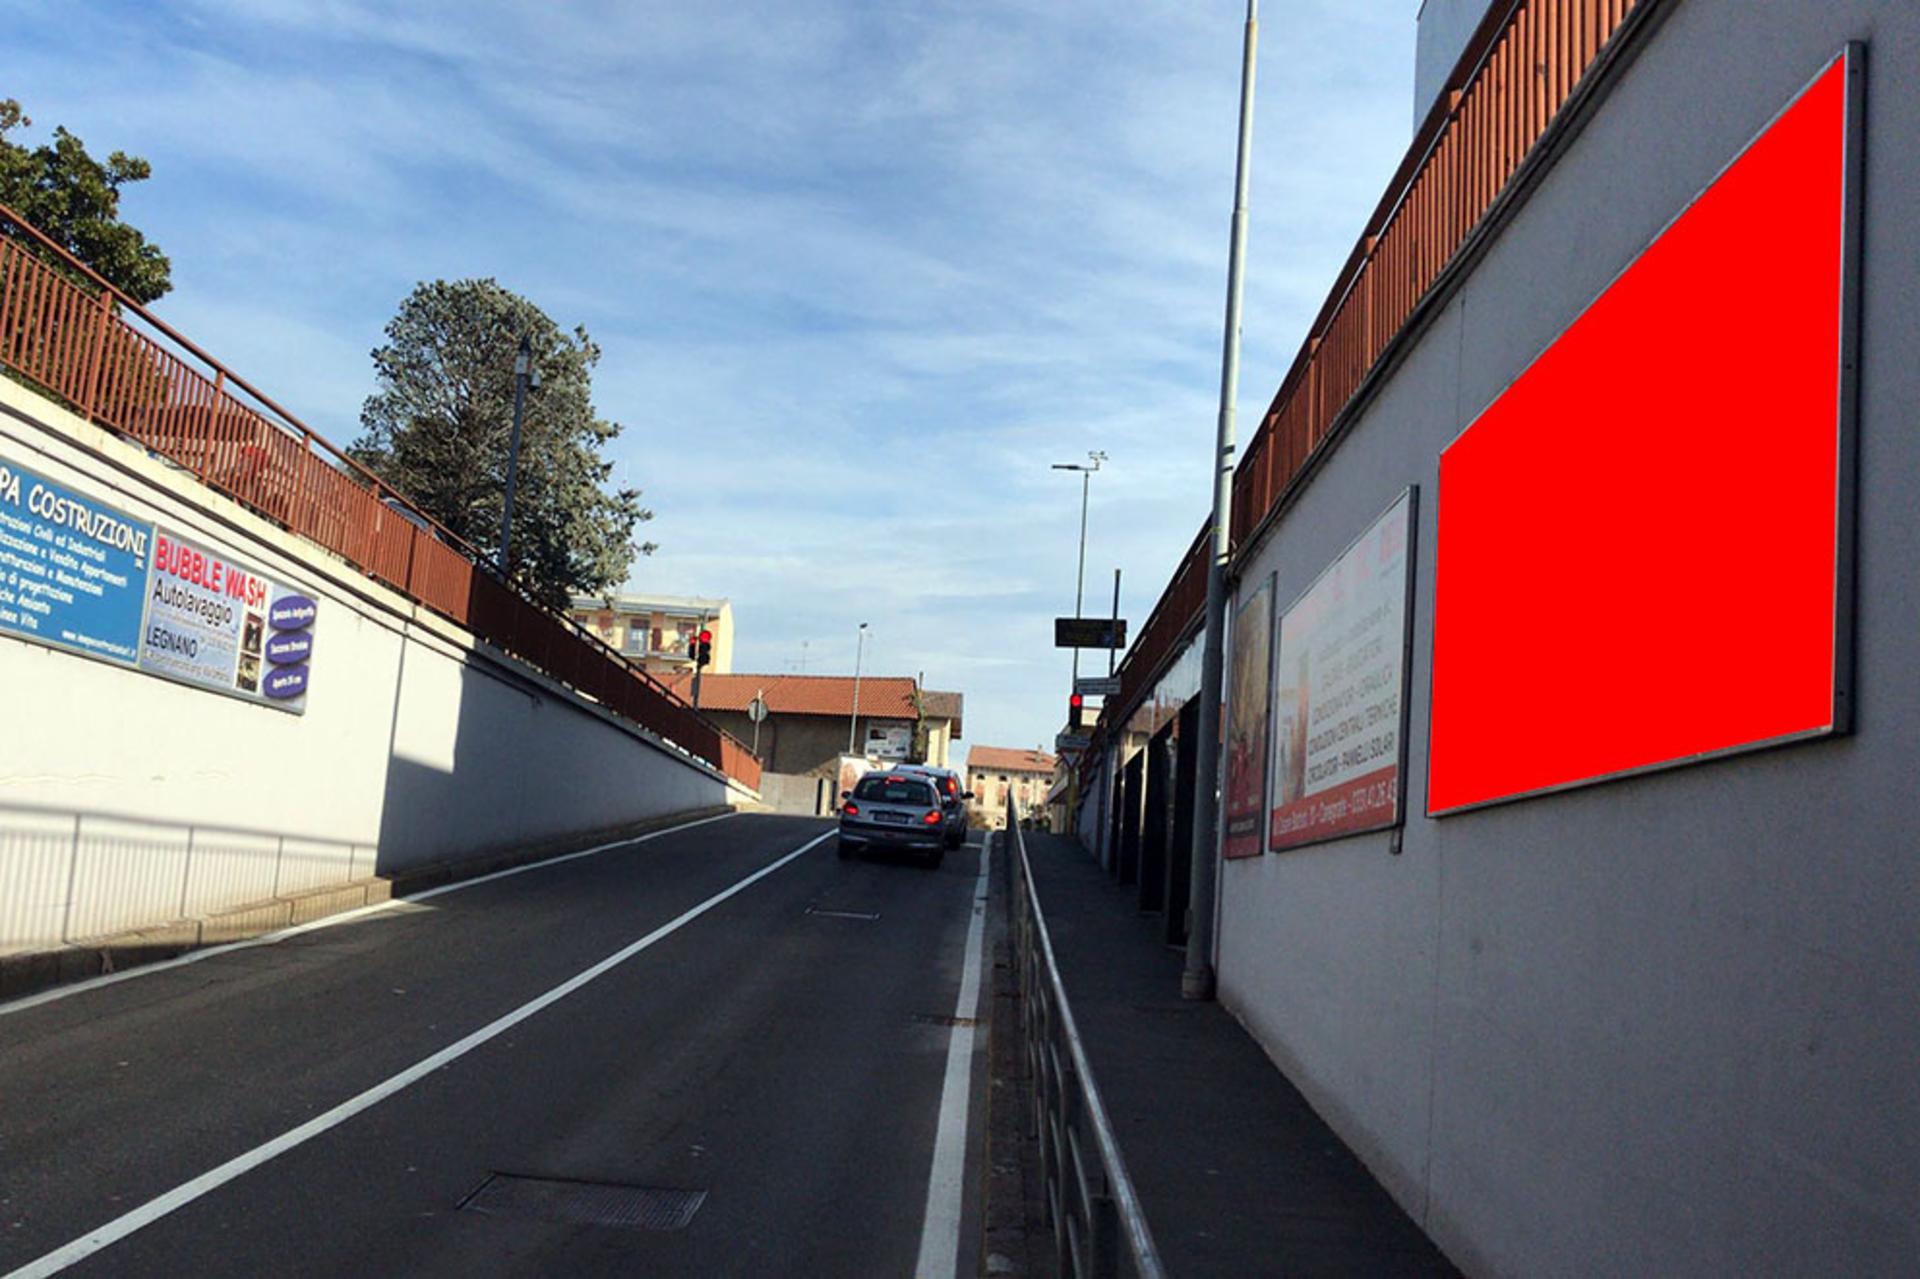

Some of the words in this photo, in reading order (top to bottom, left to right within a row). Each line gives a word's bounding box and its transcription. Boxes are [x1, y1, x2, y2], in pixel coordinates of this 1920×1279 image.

[28, 484, 147, 557] COSTRUZIONI
[153, 578, 233, 627] Autolavaggio
[155, 537, 222, 593] BUBBLE
[225, 565, 267, 611] WASH
[146, 624, 198, 658] LEGNANO
